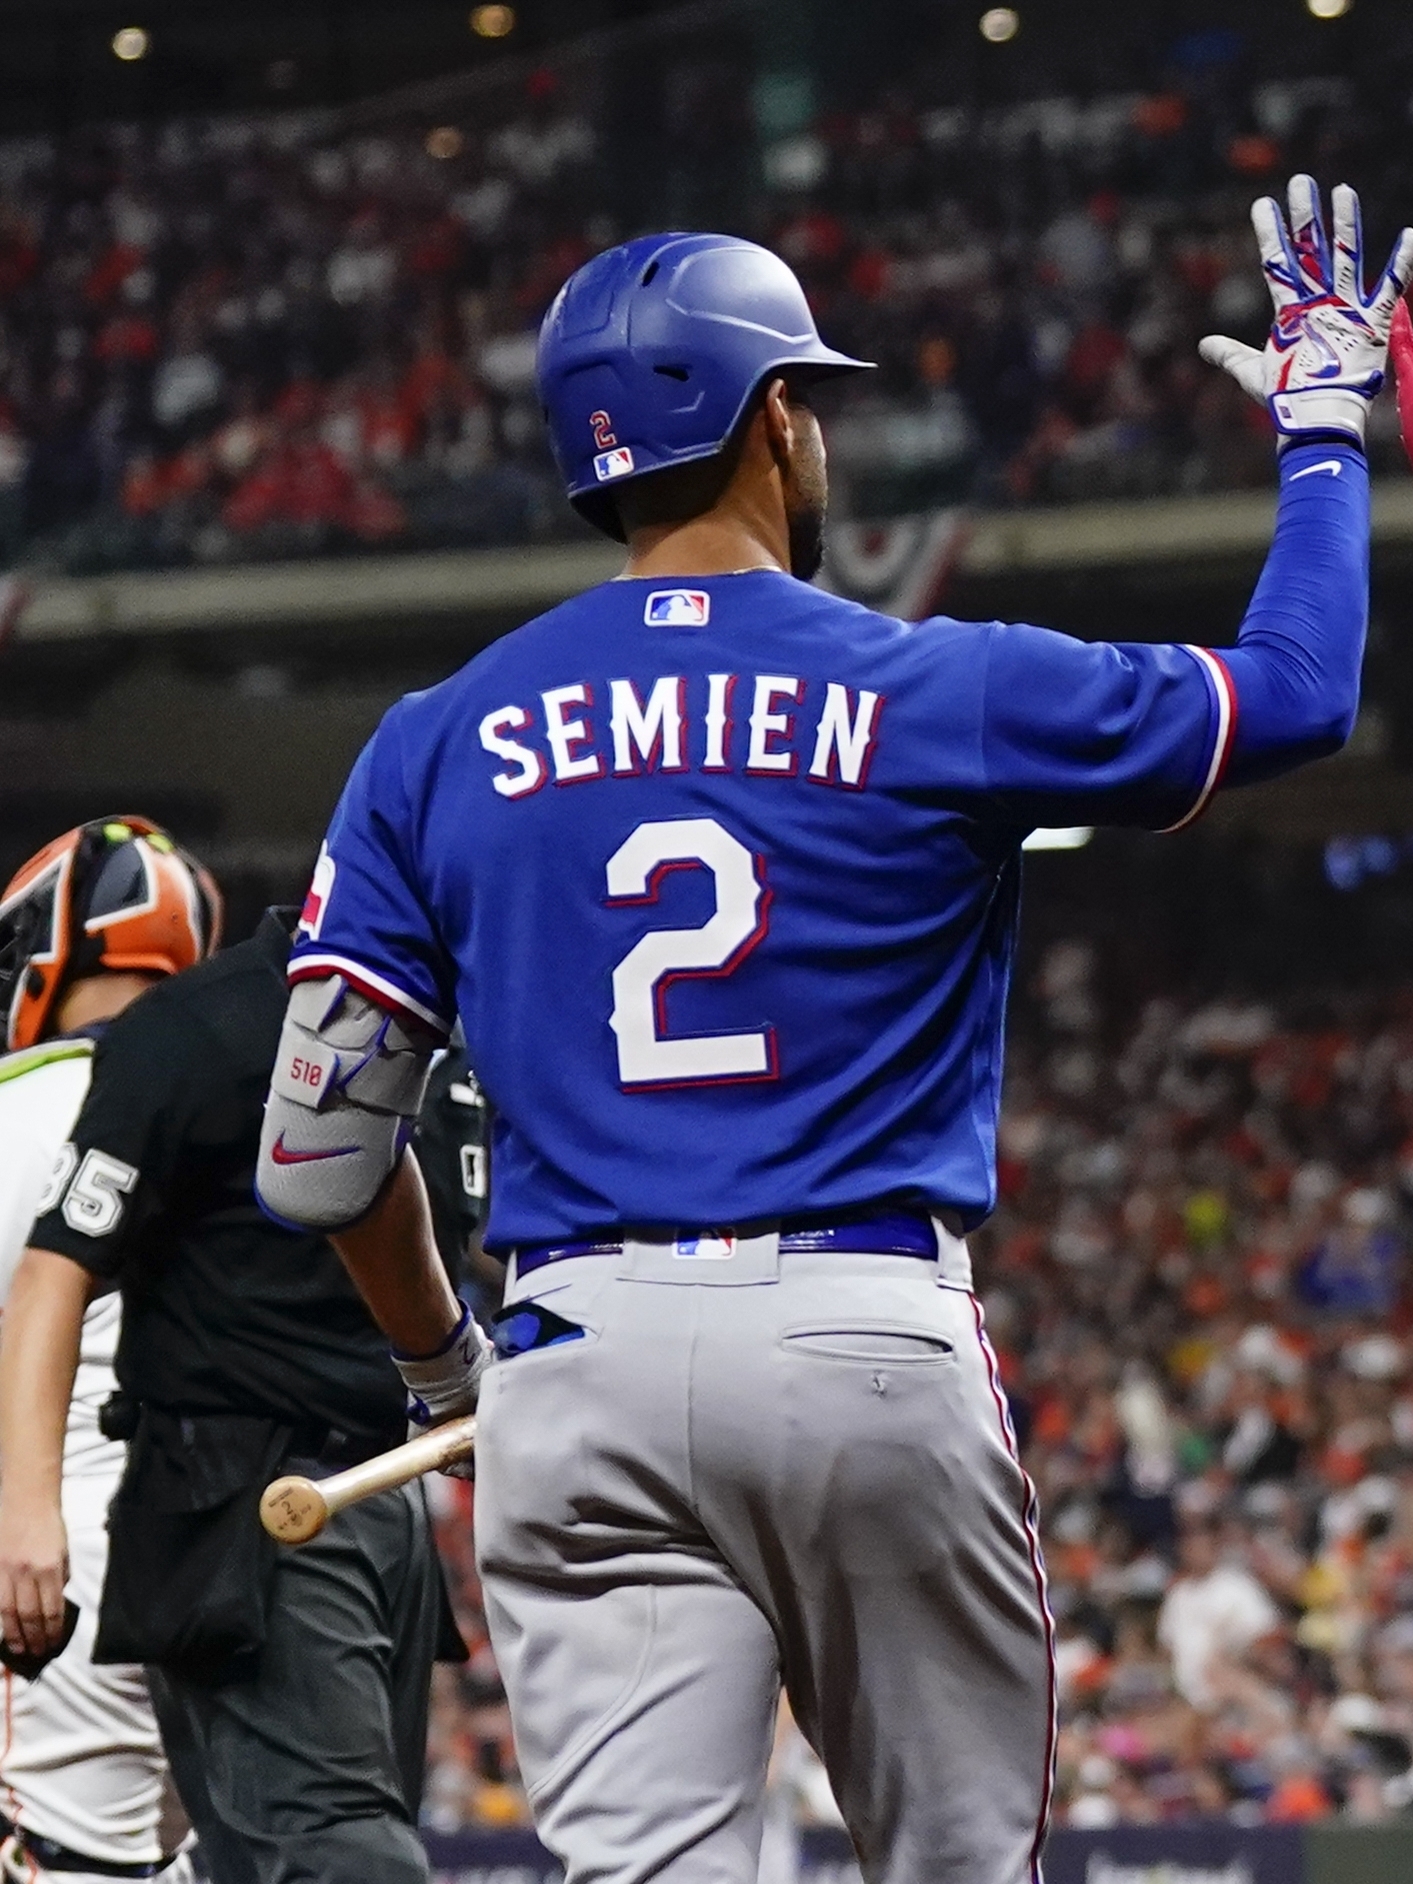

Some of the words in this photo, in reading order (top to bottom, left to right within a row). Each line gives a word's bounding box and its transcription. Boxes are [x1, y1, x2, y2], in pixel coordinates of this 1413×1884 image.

[589, 410, 617, 449] 2
[478, 673, 885, 800] SEMIEN
[604, 816, 780, 1092] 2
[290, 1056, 322, 1087] 510
